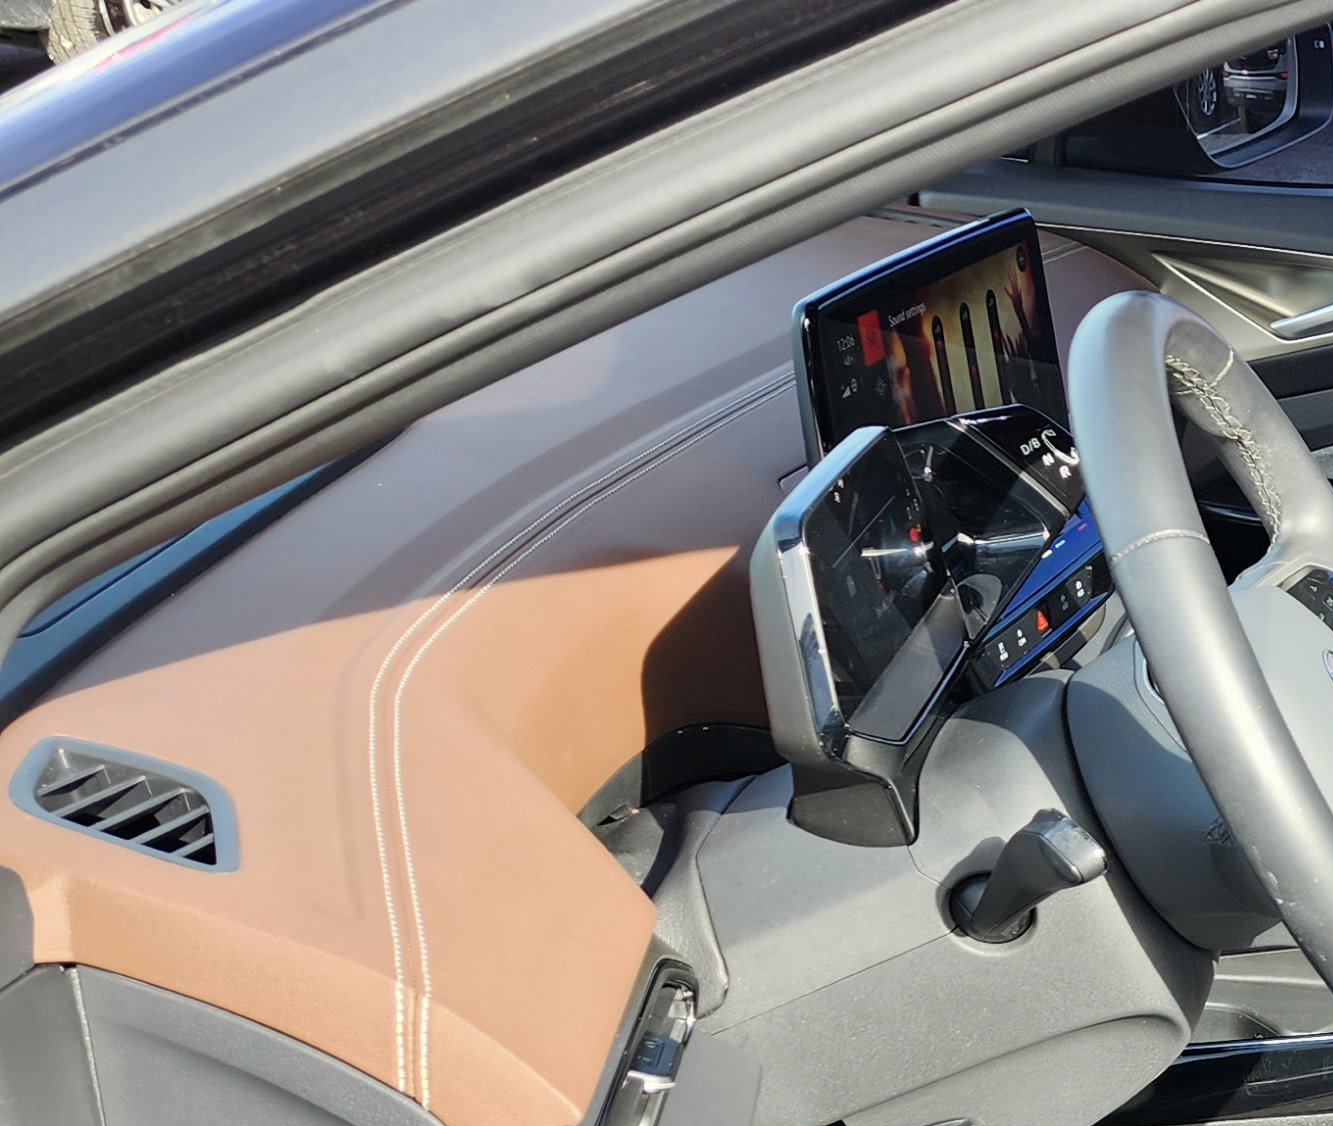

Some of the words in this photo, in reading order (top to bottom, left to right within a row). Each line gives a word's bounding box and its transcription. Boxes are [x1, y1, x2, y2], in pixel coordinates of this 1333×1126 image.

[1020, 438, 1041, 455] D/B
[1042, 452, 1055, 466] N
[1059, 465, 1072, 479] R
